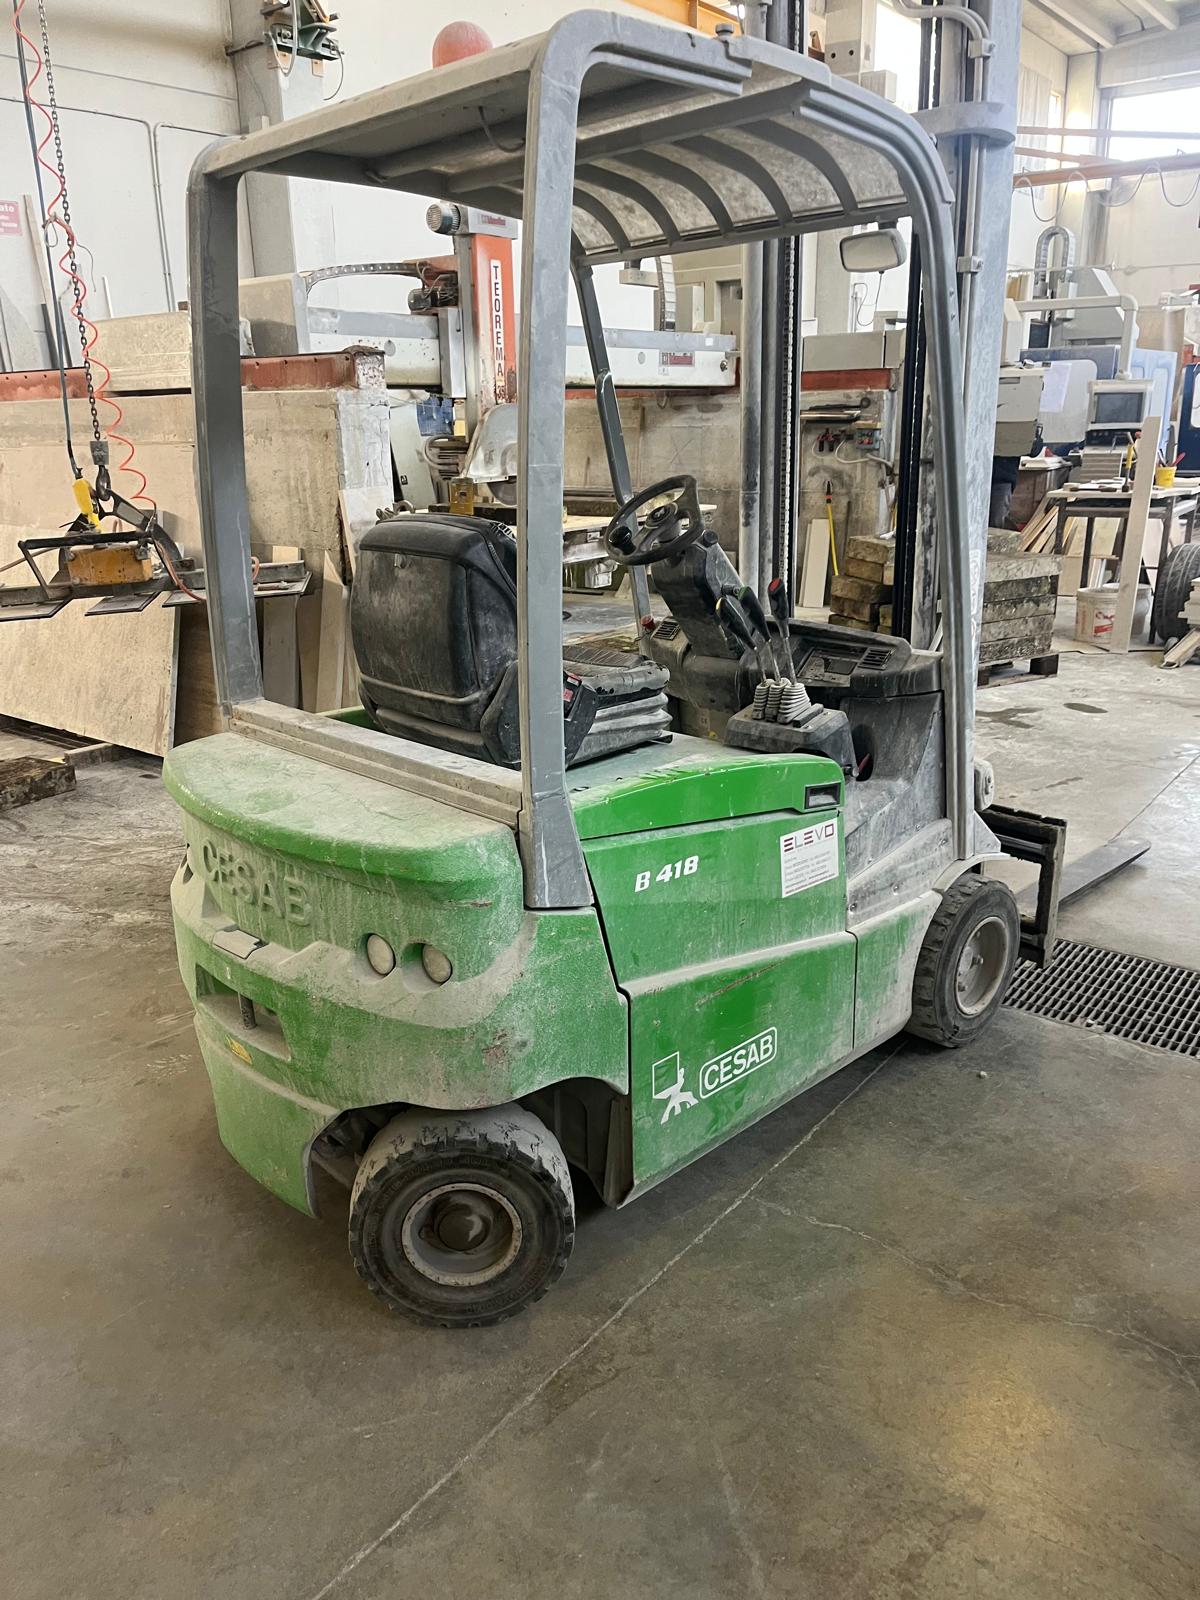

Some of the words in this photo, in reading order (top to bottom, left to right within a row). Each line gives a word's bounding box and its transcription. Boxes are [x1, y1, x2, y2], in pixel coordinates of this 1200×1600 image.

[492, 265, 504, 377] TEOREMA
[783, 823, 835, 853] ELEVO
[201, 839, 310, 927] CESAB
[634, 870, 651, 893] B
[655, 855, 699, 883] 418
[704, 1034, 773, 1091] CESAB
